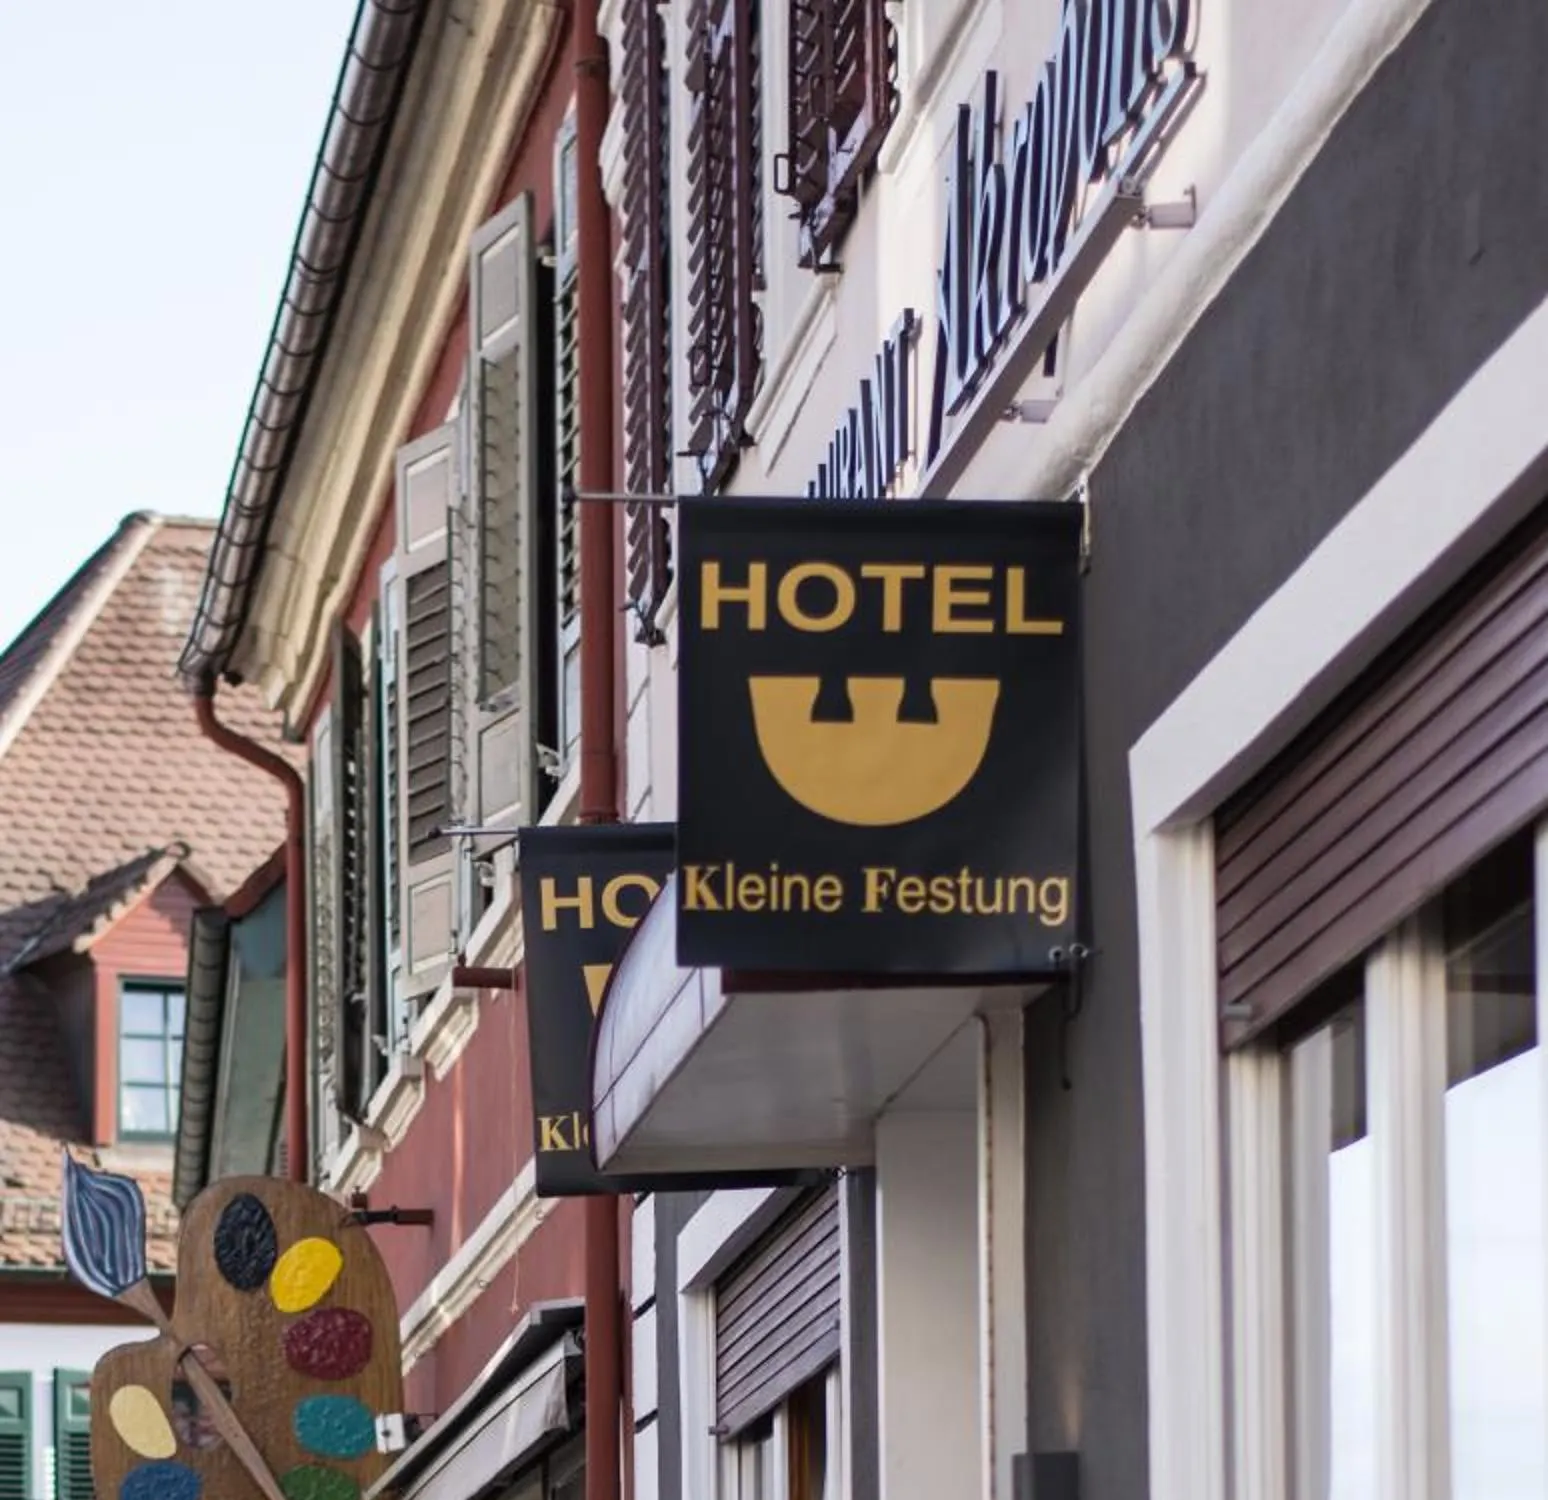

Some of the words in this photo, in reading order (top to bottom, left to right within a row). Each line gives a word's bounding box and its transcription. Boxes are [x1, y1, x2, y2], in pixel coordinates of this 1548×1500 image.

[701, 561, 1064, 634] HOTEL
[683, 862, 843, 912] Kleine
[861, 866, 1070, 927] Festung
